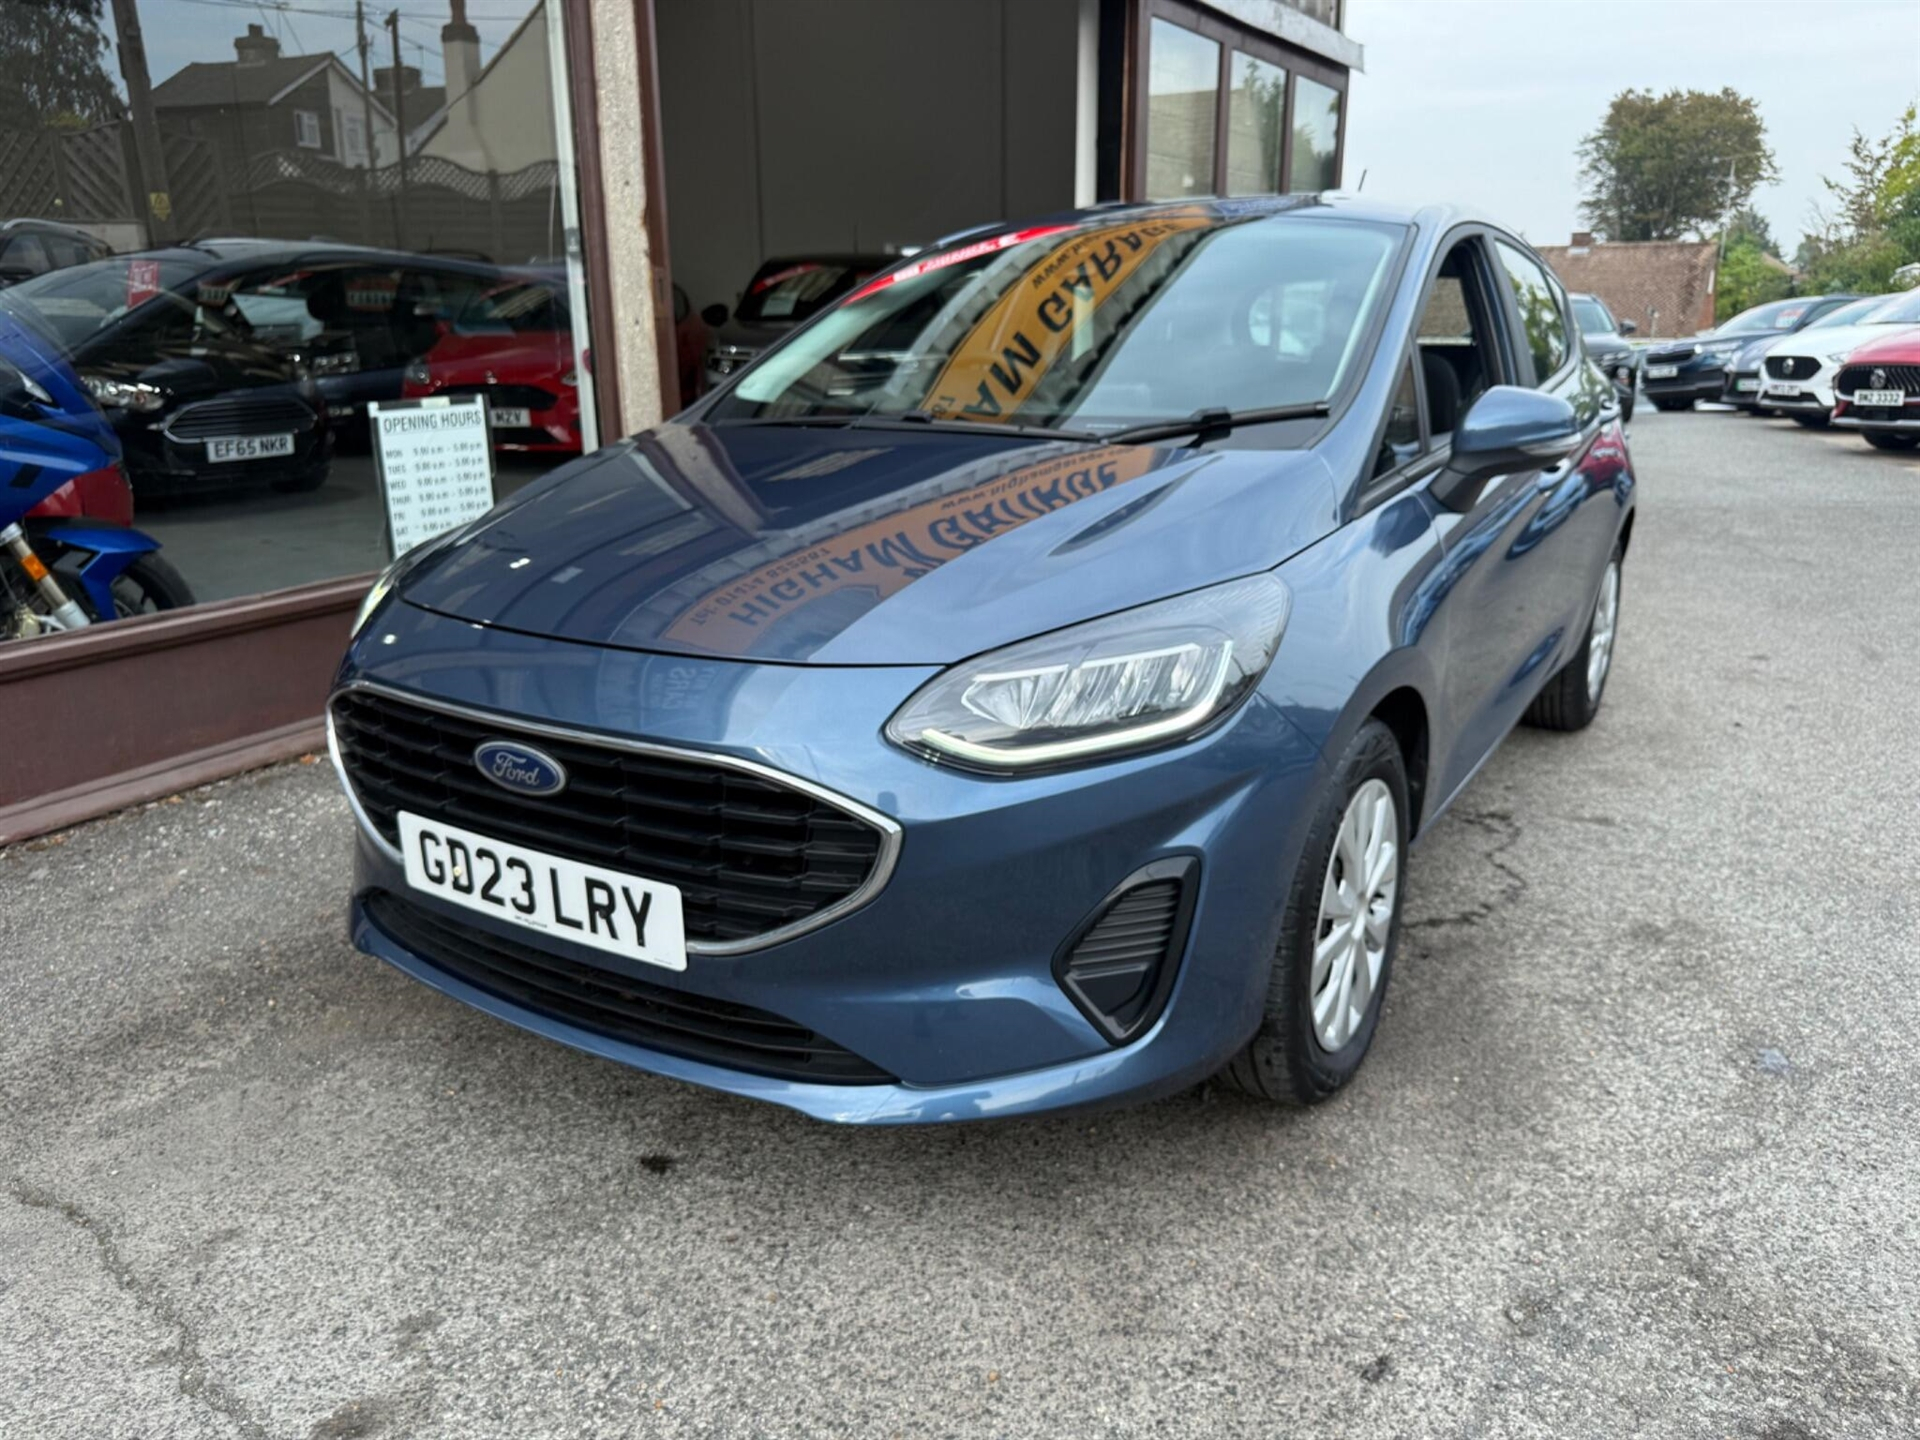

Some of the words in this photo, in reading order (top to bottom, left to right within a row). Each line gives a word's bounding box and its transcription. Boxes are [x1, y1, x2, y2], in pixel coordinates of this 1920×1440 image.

[384, 414, 438, 434] OPENING
[441, 410, 482, 428] HOURS
[214, 439, 257, 459] EF65
[260, 435, 290, 453] NKR
[493, 751, 541, 785] Ford
[419, 829, 538, 916] GD23
[549, 867, 653, 949] LRY
